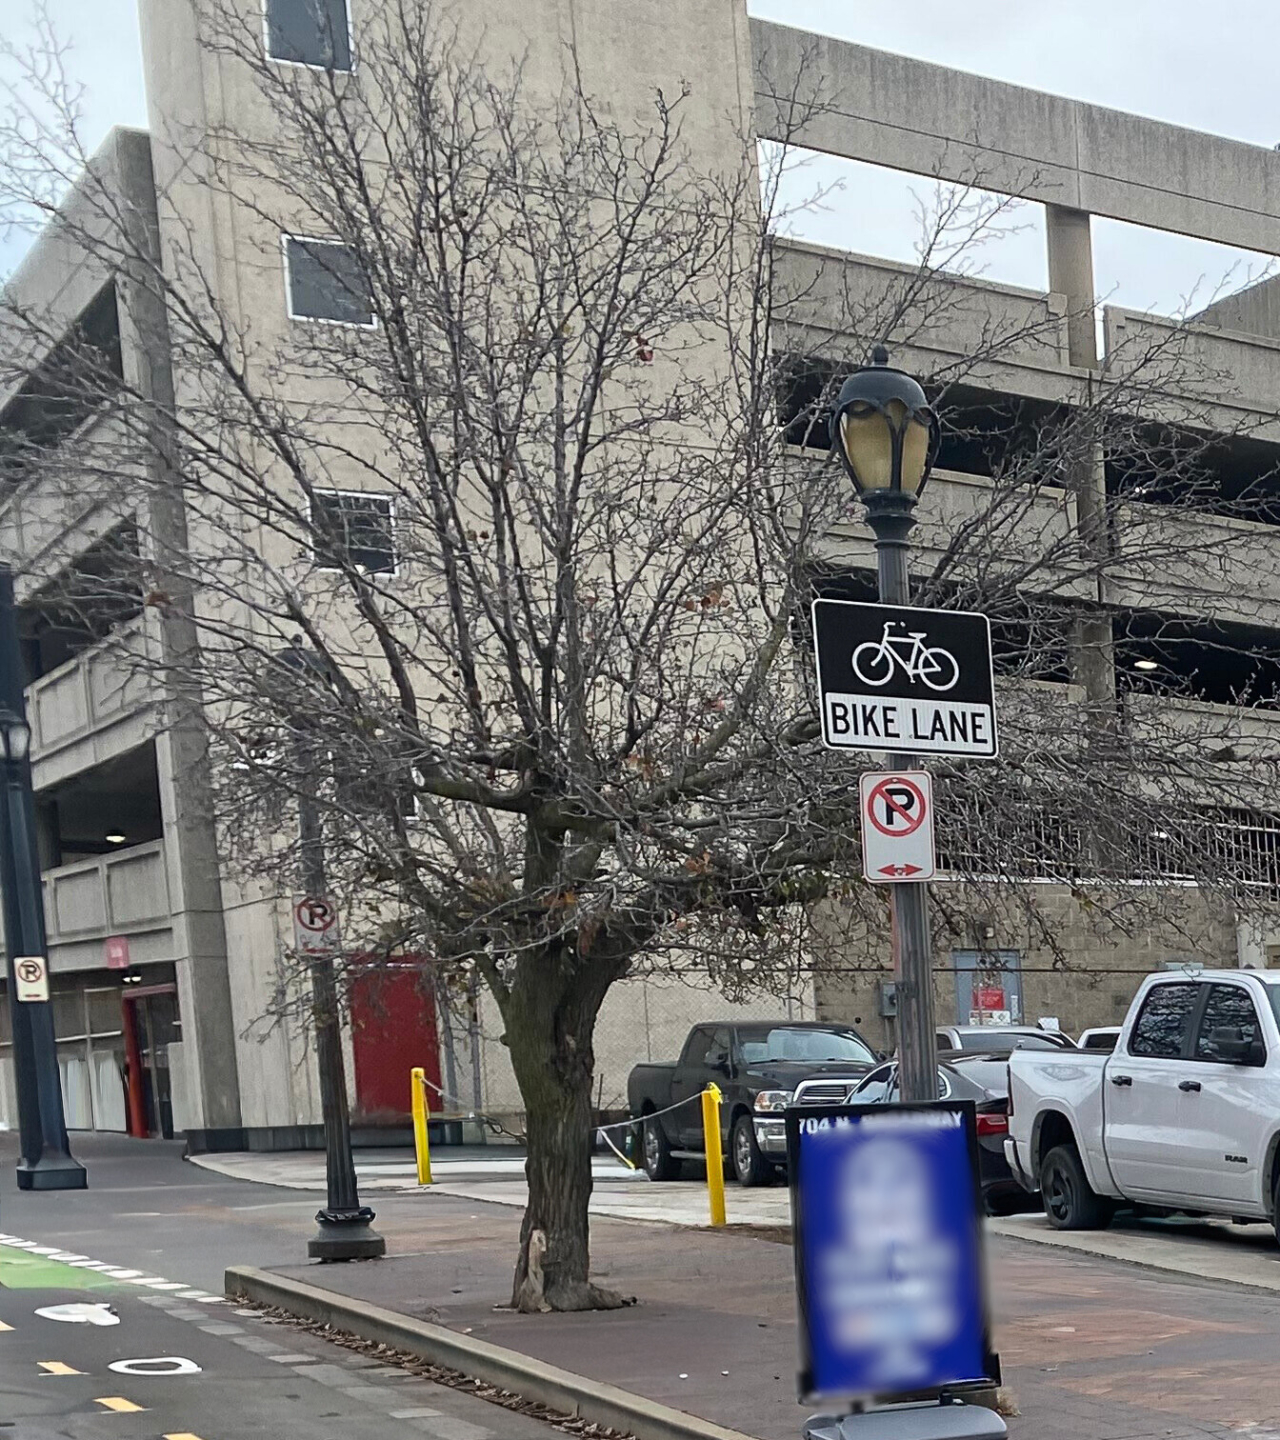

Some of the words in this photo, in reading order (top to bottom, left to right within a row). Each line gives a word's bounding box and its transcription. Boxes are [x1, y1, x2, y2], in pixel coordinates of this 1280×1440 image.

[831, 702, 900, 738] BIKE
[911, 707, 988, 744] LANE
[798, 1116, 829, 1135] 704
[1225, 1154, 1248, 1164] RAM
